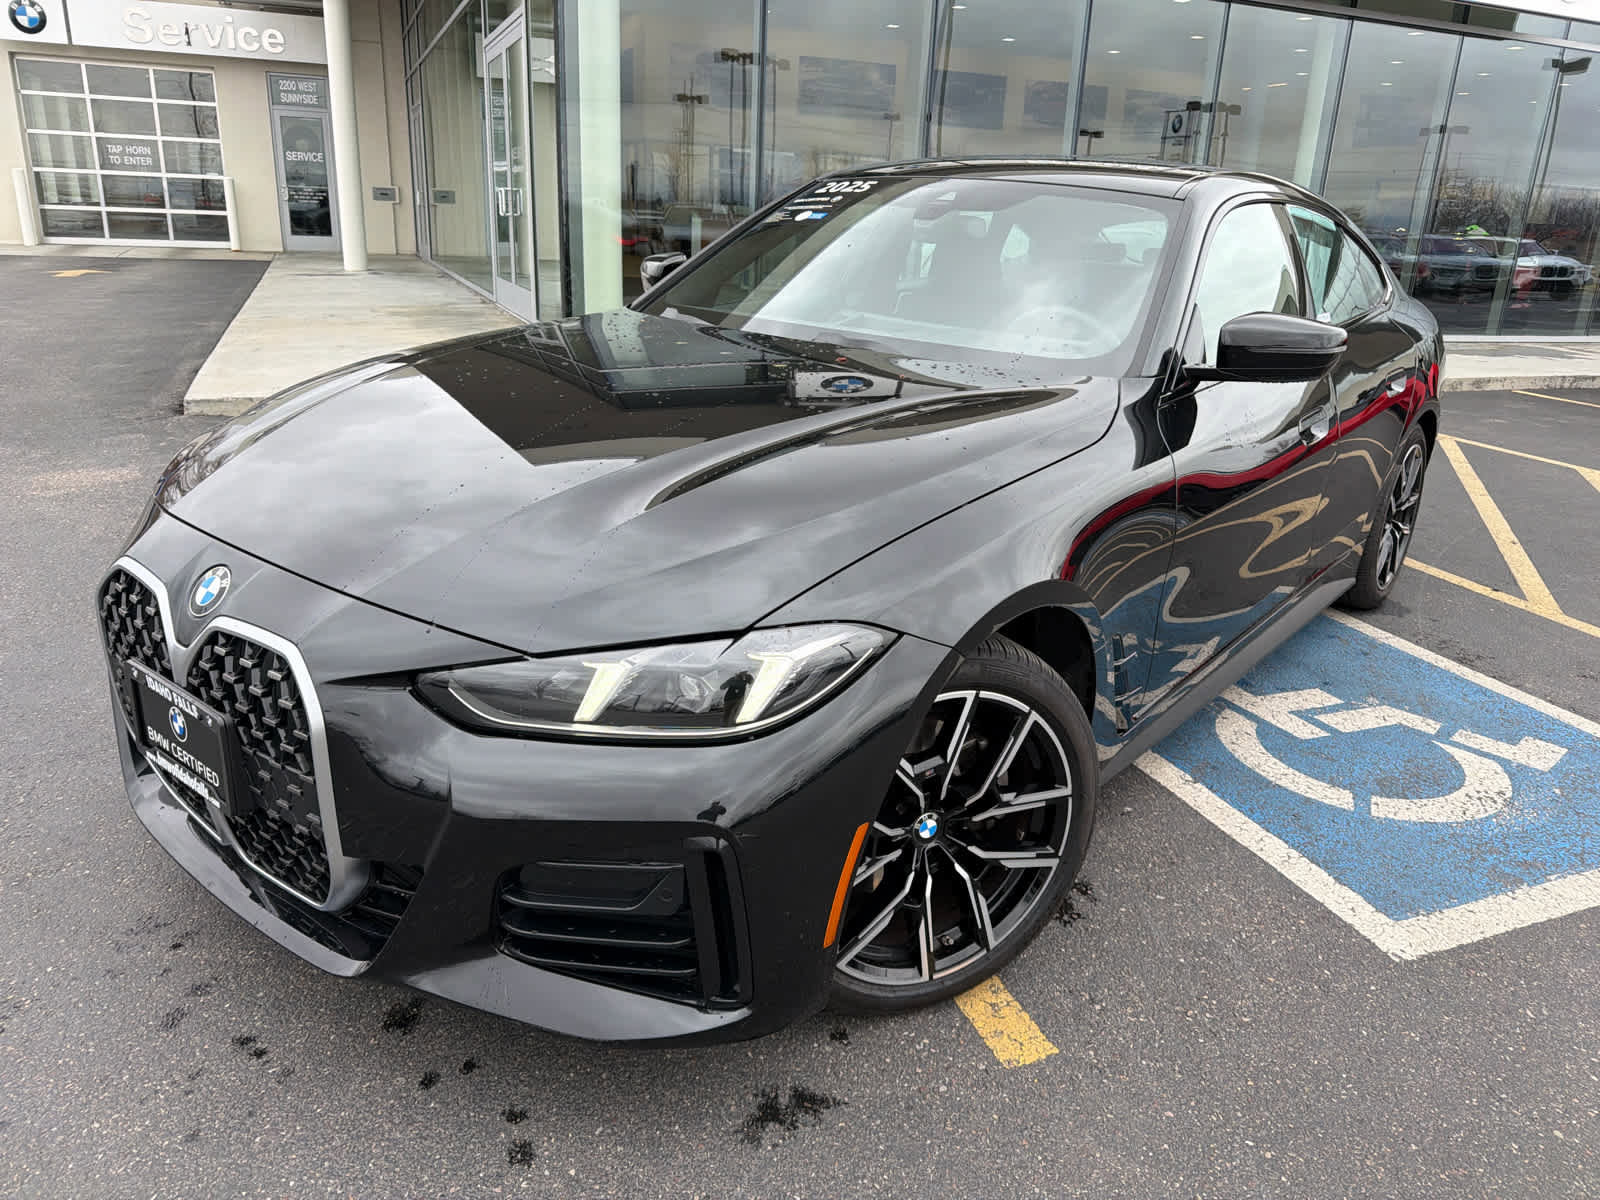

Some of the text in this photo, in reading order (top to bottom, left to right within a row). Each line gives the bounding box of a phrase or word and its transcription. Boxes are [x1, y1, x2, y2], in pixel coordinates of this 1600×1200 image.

[122, 7, 285, 53] Service
[279, 80, 318, 92] 2200 WEST
[280, 92, 319, 104] SUNNYSIDE
[105, 144, 151, 155] TAP HORN
[108, 155, 153, 166] TO ENTER
[285, 151, 325, 162] SERVICE
[815, 181, 879, 194] 2025
[145, 674, 199, 719] IDAHO FALLS
[147, 726, 220, 787] BMW CERTIFIED
